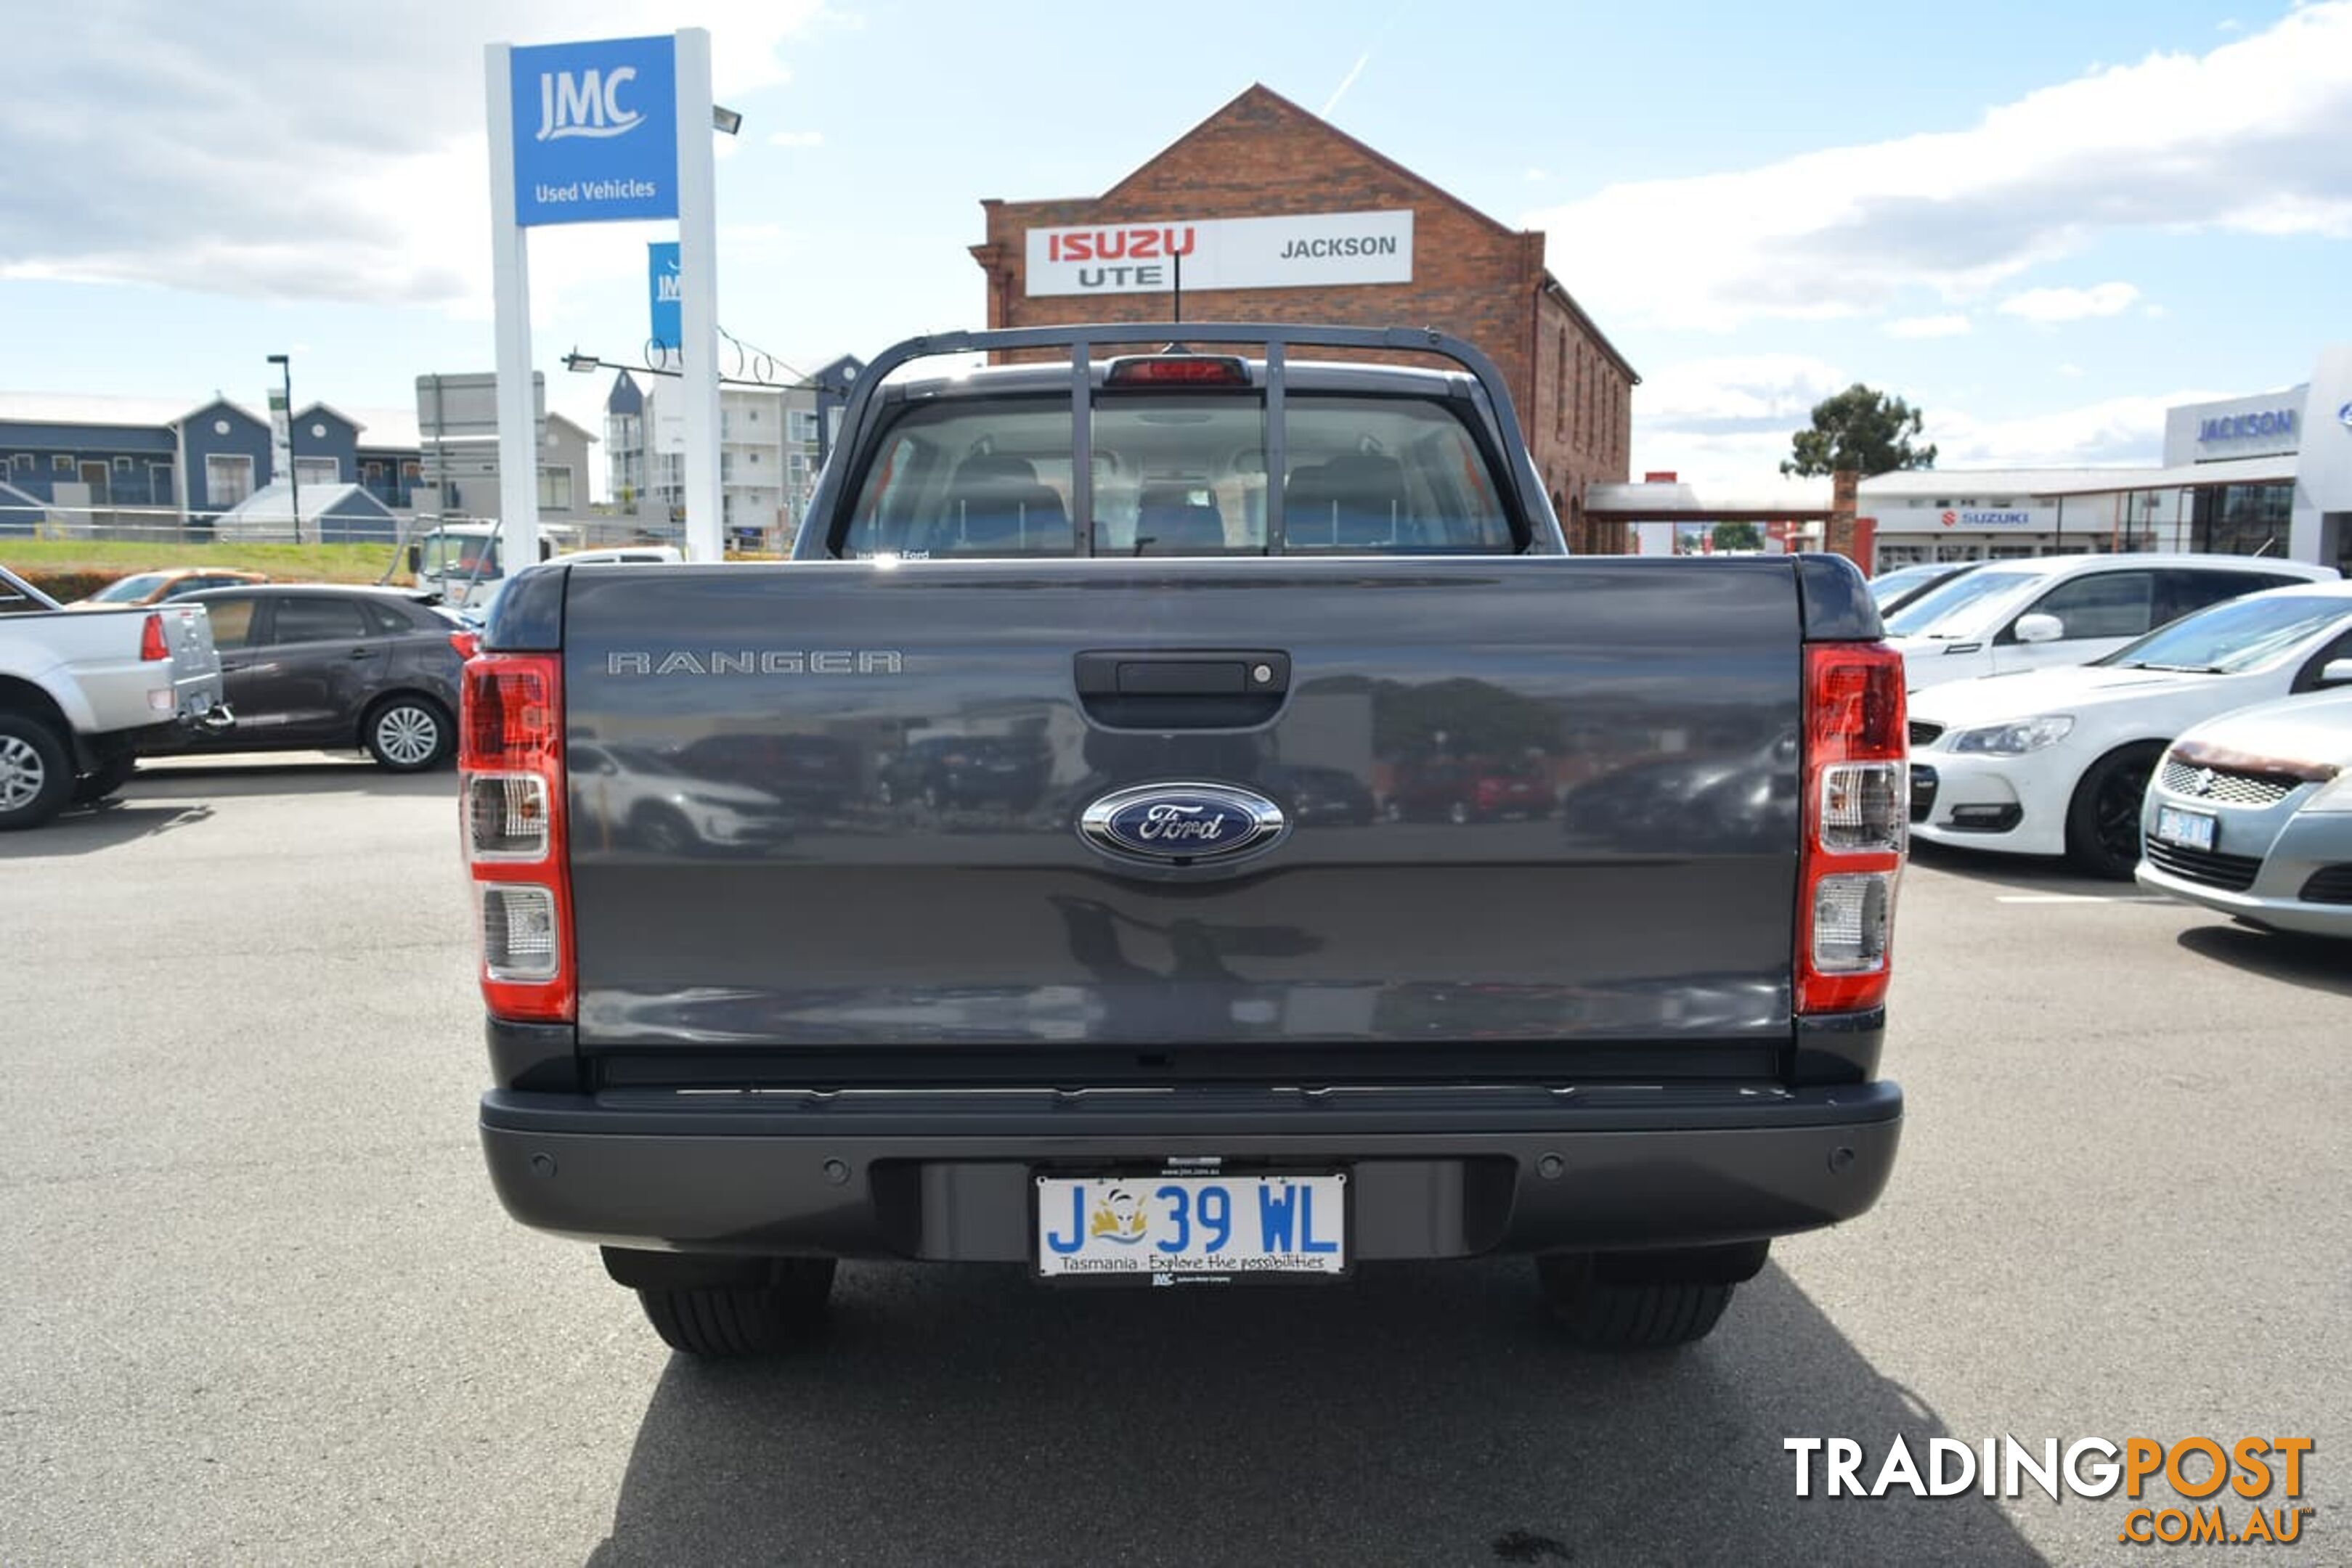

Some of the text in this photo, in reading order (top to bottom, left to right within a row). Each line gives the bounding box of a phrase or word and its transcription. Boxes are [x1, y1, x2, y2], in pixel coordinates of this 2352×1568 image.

[536, 66, 639, 142] JMC
[536, 179, 656, 203] Used Vehicles
[1049, 226, 1195, 262] ISUZU
[1280, 236, 1397, 260] JACKSON
[656, 274, 681, 302] JM
[1078, 265, 1163, 288] UTE
[2197, 408, 2296, 441] JACKSON
[1962, 512, 2029, 525] SUZUKI
[607, 650, 903, 676] RANGER
[1139, 804, 1224, 839] Ford
[1046, 1185, 1339, 1254] J 39 WL
[1061, 1254, 1324, 1271] Tasmania Explore the possibilities
